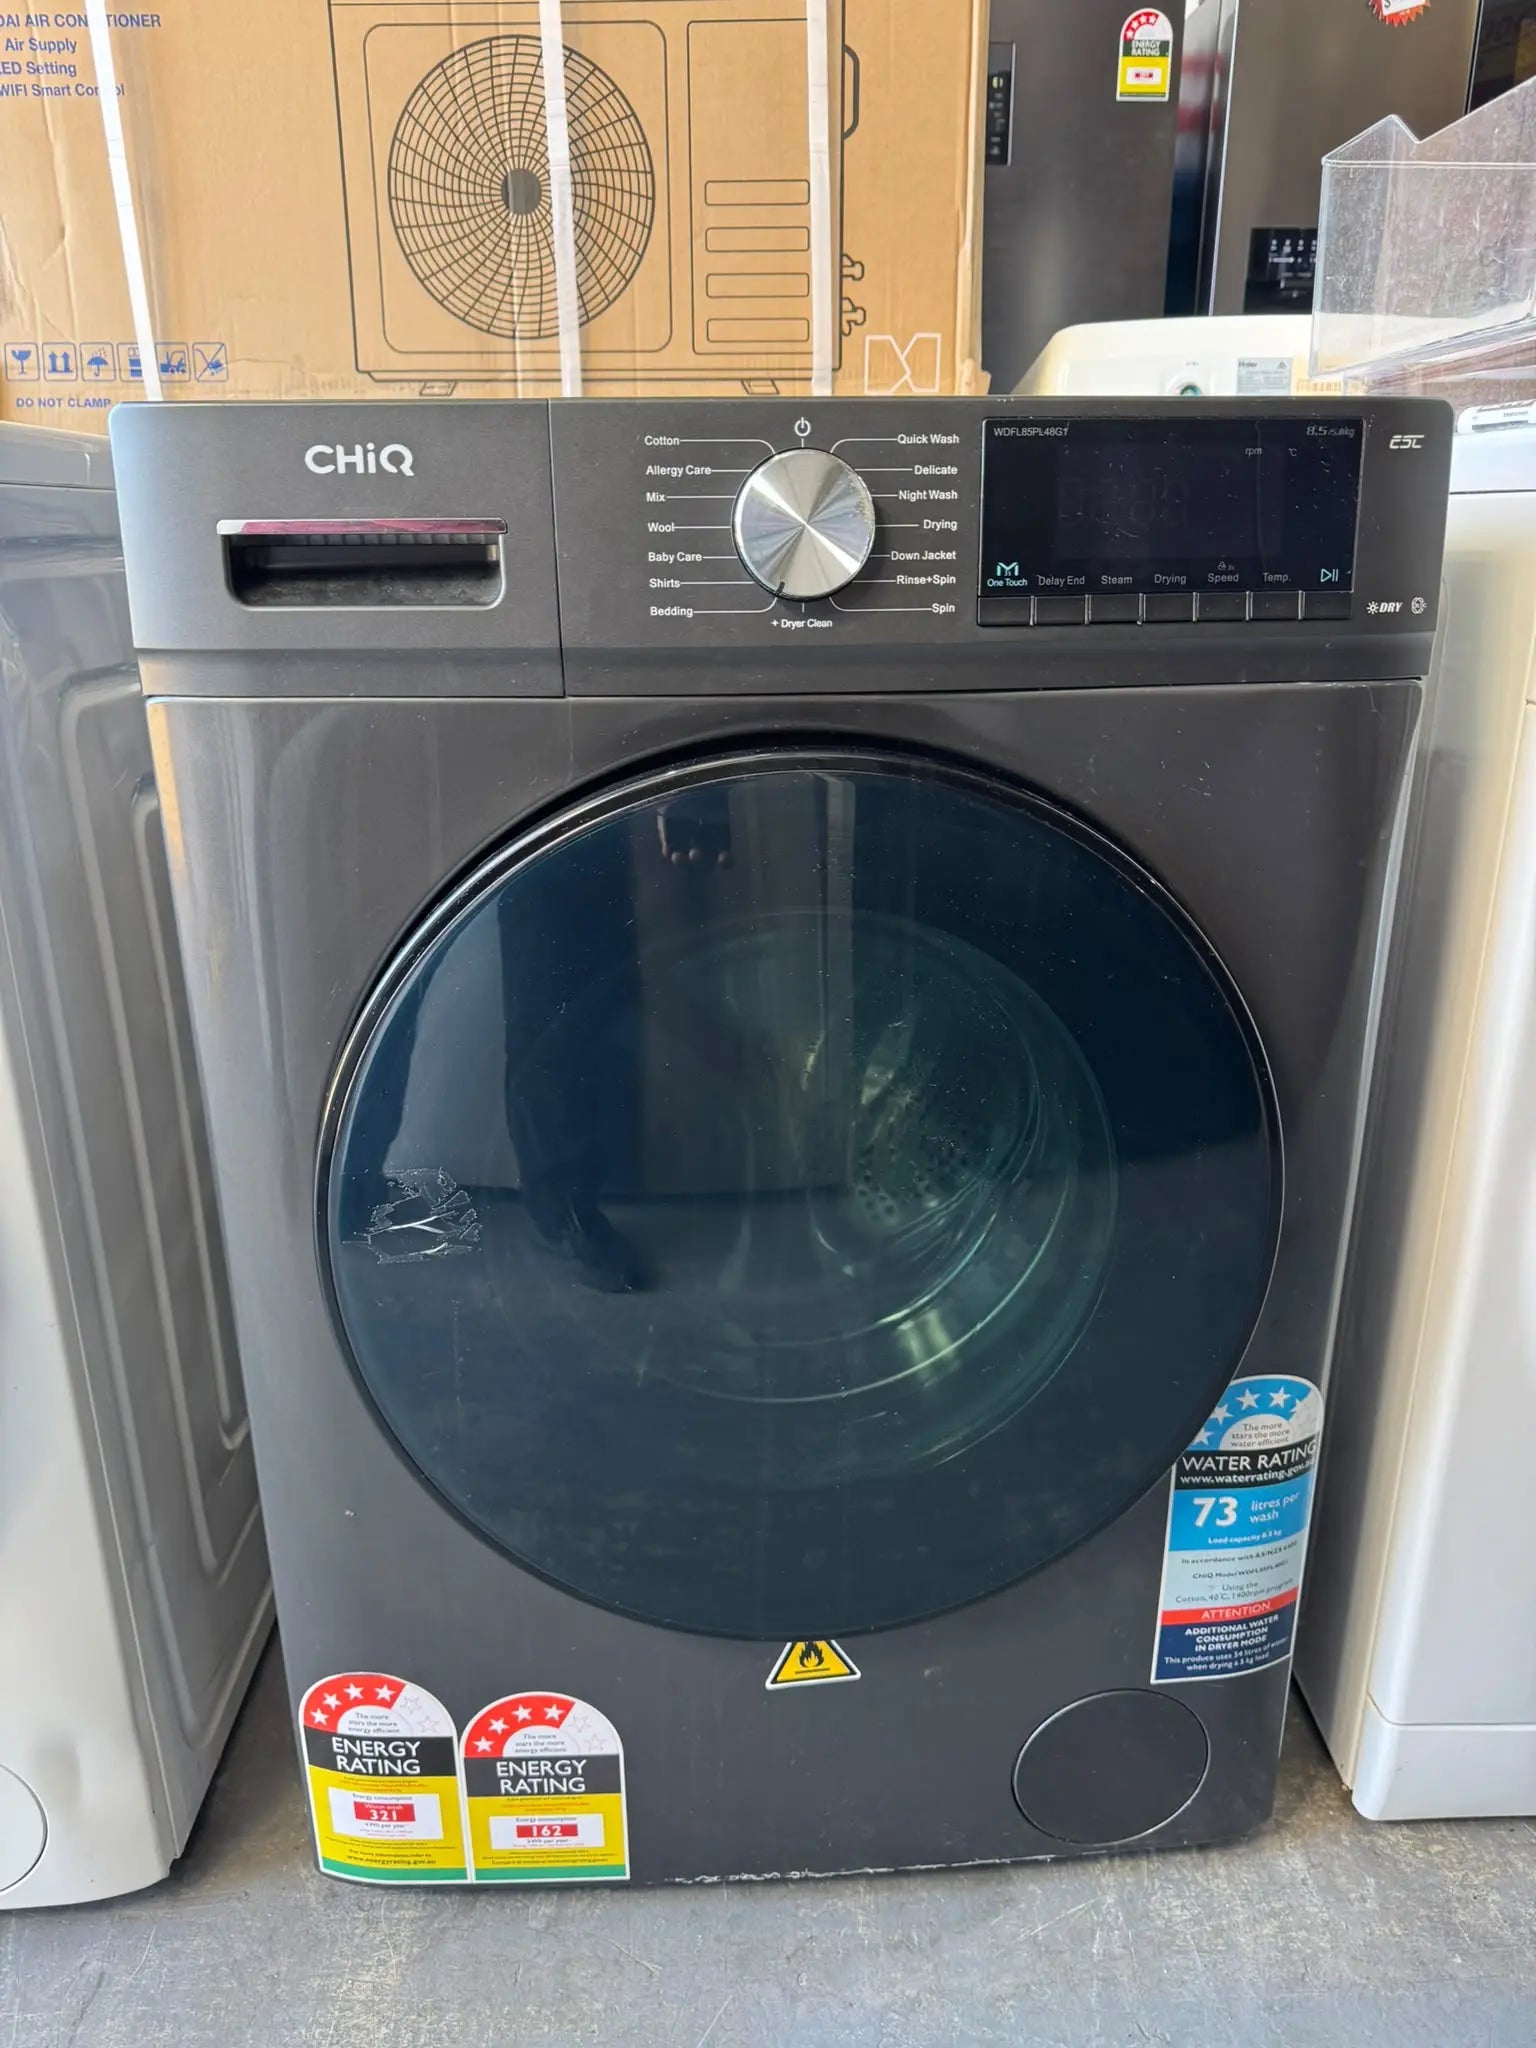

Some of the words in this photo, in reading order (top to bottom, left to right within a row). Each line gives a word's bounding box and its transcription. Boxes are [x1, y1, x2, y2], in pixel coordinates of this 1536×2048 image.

[25, 14, 50, 27] AIR
[54, 13, 161, 28] CONTIONER
[5, 38, 24, 51] Air
[28, 37, 77, 54] Supply
[26, 61, 77, 78] Setting
[32, 84, 71, 97] Smart
[16, 398, 34, 407] DO
[38, 398, 63, 408] NOT
[67, 398, 111, 408] CLAMP
[644, 436, 680, 446] Cotton
[897, 434, 928, 445] Quick
[930, 434, 960, 444] Wash
[1245, 447, 1262, 456] rpm
[305, 442, 414, 476] CHiQ
[646, 465, 684, 477] Allergy
[686, 465, 712, 475] Care
[914, 465, 958, 475] Delicate
[646, 492, 666, 502] Mix
[898, 490, 928, 502] Night
[928, 490, 958, 500] Wash
[648, 523, 675, 532] Wool
[923, 520, 958, 531] Drying
[649, 553, 674, 564] Baby
[677, 553, 702, 562] Care
[891, 551, 920, 561] Down
[922, 551, 956, 561] Jacket
[649, 579, 681, 588] Shirts
[897, 575, 956, 587] Rinse+Spin
[987, 578, 1003, 587] One
[1006, 578, 1028, 587] Touch
[1038, 576, 1065, 588] Delay
[1067, 576, 1085, 585] End
[1101, 575, 1133, 585] Steam
[1154, 574, 1186, 585] Drying
[1208, 573, 1239, 584] Speed
[1263, 573, 1291, 584] Temp.
[650, 607, 693, 617] Bedding
[932, 604, 955, 615] Spin
[1379, 602, 1403, 613] DRY
[781, 619, 805, 630] Dryer
[807, 619, 833, 628] Clean
[1258, 1437, 1288, 1446] efficient
[1182, 1456, 1251, 1471] WATER
[1257, 1440, 1317, 1470] RATING
[1251, 1499, 1281, 1511] litres
[1283, 1492, 1299, 1507] per
[1193, 1496, 1238, 1527] 73
[1250, 1510, 1279, 1523] wash
[1222, 1584, 1243, 1592] Using
[1202, 1601, 1271, 1619] ATTENTION
[1185, 1622, 1248, 1636] ADDITIONAL
[1249, 1614, 1279, 1629] WATER
[1196, 1626, 1268, 1643] CONSUMPTION
[1208, 1639, 1239, 1651] DRYER
[1241, 1634, 1267, 1647] MODE
[1164, 1656, 1180, 1664] This
[1209, 1660, 1233, 1670] drying
[332, 1736, 420, 1757] ENERGY
[336, 1754, 420, 1775] RATING
[496, 1759, 587, 1777] ENERGY
[500, 1777, 586, 1794] RATING
[369, 1809, 398, 1821] 321
[531, 1825, 562, 1837] 162
